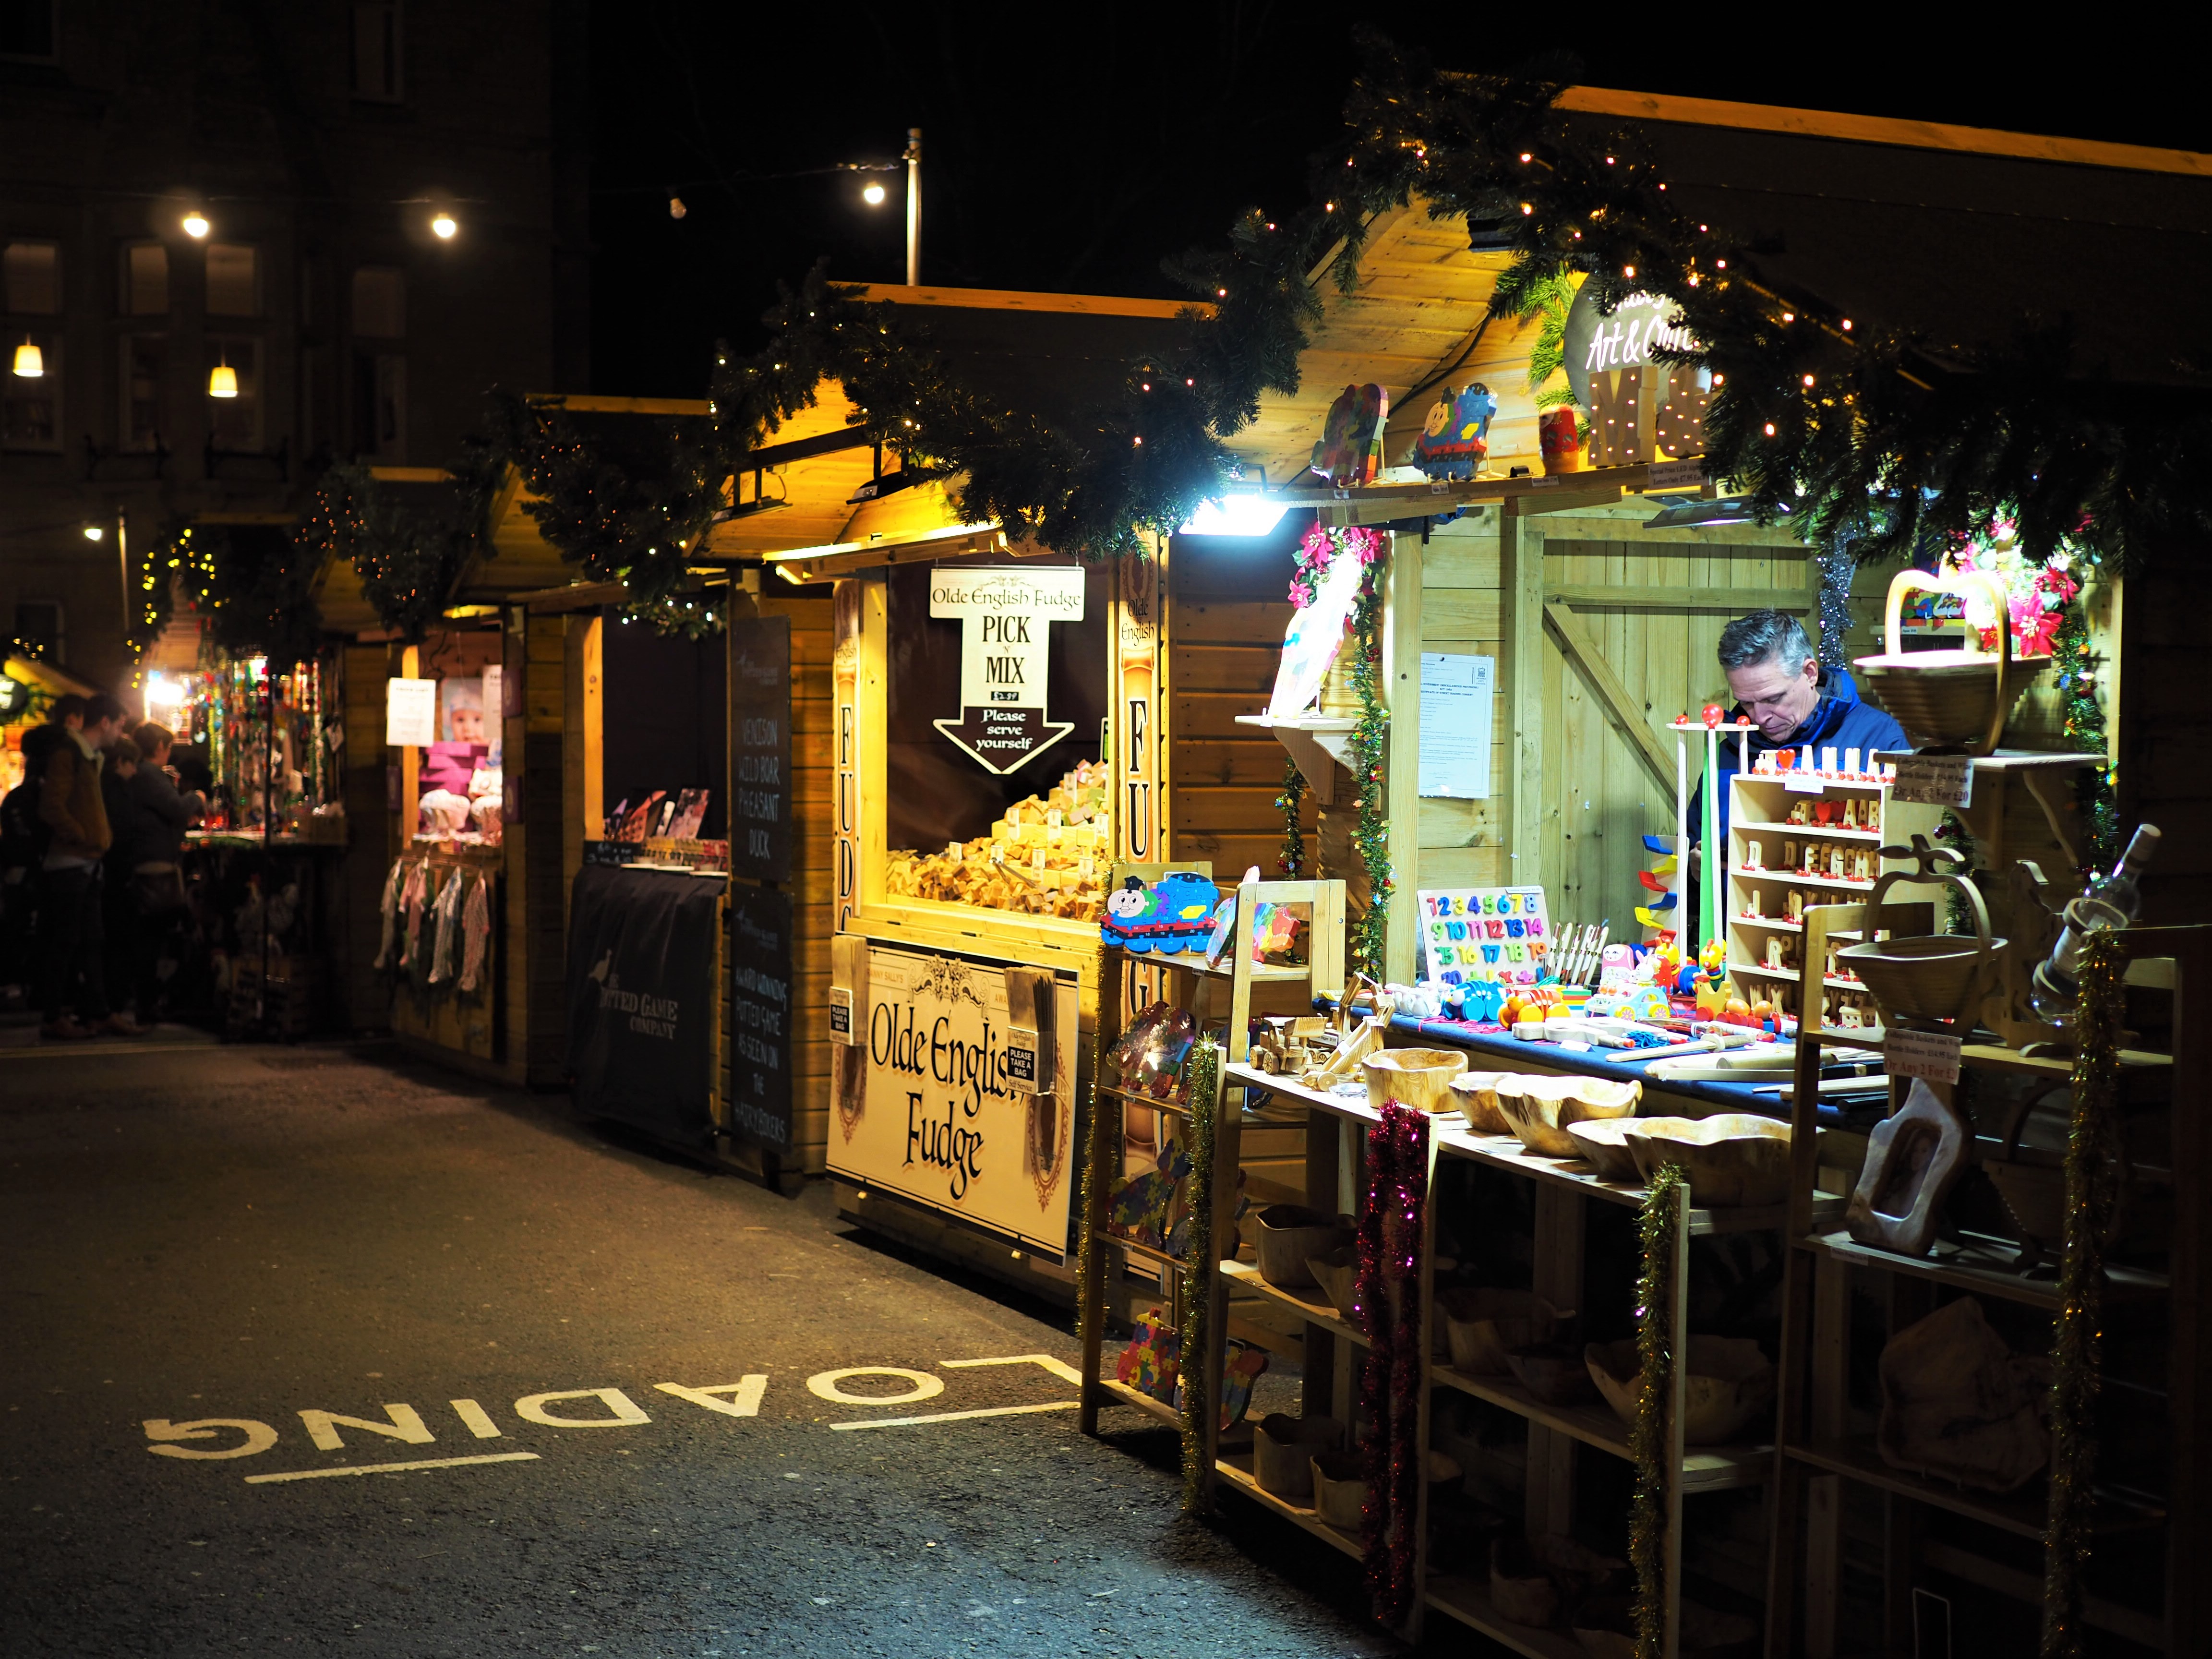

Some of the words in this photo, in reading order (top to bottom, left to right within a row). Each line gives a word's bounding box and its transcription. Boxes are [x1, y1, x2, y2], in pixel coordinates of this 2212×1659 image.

[1585, 321, 1624, 373] Art
[1623, 319, 1640, 363] &
[932, 588, 968, 603] Olde
[972, 589, 1029, 610] English
[1034, 590, 1081, 611] Fudge
[1127, 599, 1149, 618] Olde
[982, 615, 1031, 643] PICK
[1121, 622, 1154, 647] English
[986, 656, 1025, 684] MIX
[980, 709, 1026, 723] Please
[742, 718, 778, 746] VENISON
[986, 726, 1023, 735] serve
[976, 737, 1033, 752] yourself
[1893, 784, 1907, 796] Or
[1936, 788, 1952, 800] For
[1953, 790, 1969, 802] £20
[738, 787, 780, 822] PHEASANT
[748, 829, 770, 859] DUCK
[885, 971, 903, 983] SALLY'S
[641, 992, 679, 1022] GAME
[995, 994, 1008, 1004] AWA
[832, 1006, 848, 1016] PLEASE
[832, 1013, 843, 1022] TAKE
[630, 1015, 676, 1040] COMPANY
[746, 1035, 768, 1065] SEEN
[871, 1003, 927, 1075] Olde
[931, 1010, 1024, 1118] Englis
[1010, 1049, 1032, 1061] PLEASE
[1927, 1049, 1946, 1058] £14.95
[1010, 1058, 1026, 1068] TAKE
[1014, 1069, 1027, 1077] BAG
[1884, 1058, 1897, 1070] Or
[1900, 1061, 1918, 1076] Any
[1921, 1064, 1925, 1074] 2
[1928, 1064, 1944, 1078] For
[753, 1072, 764, 1095] THE
[1009, 1080, 1017, 1088] Self
[1017, 1082, 1033, 1091] Service
[902, 1089, 984, 1200] Fudge
[143, 1354, 1083, 1460] LOADING
